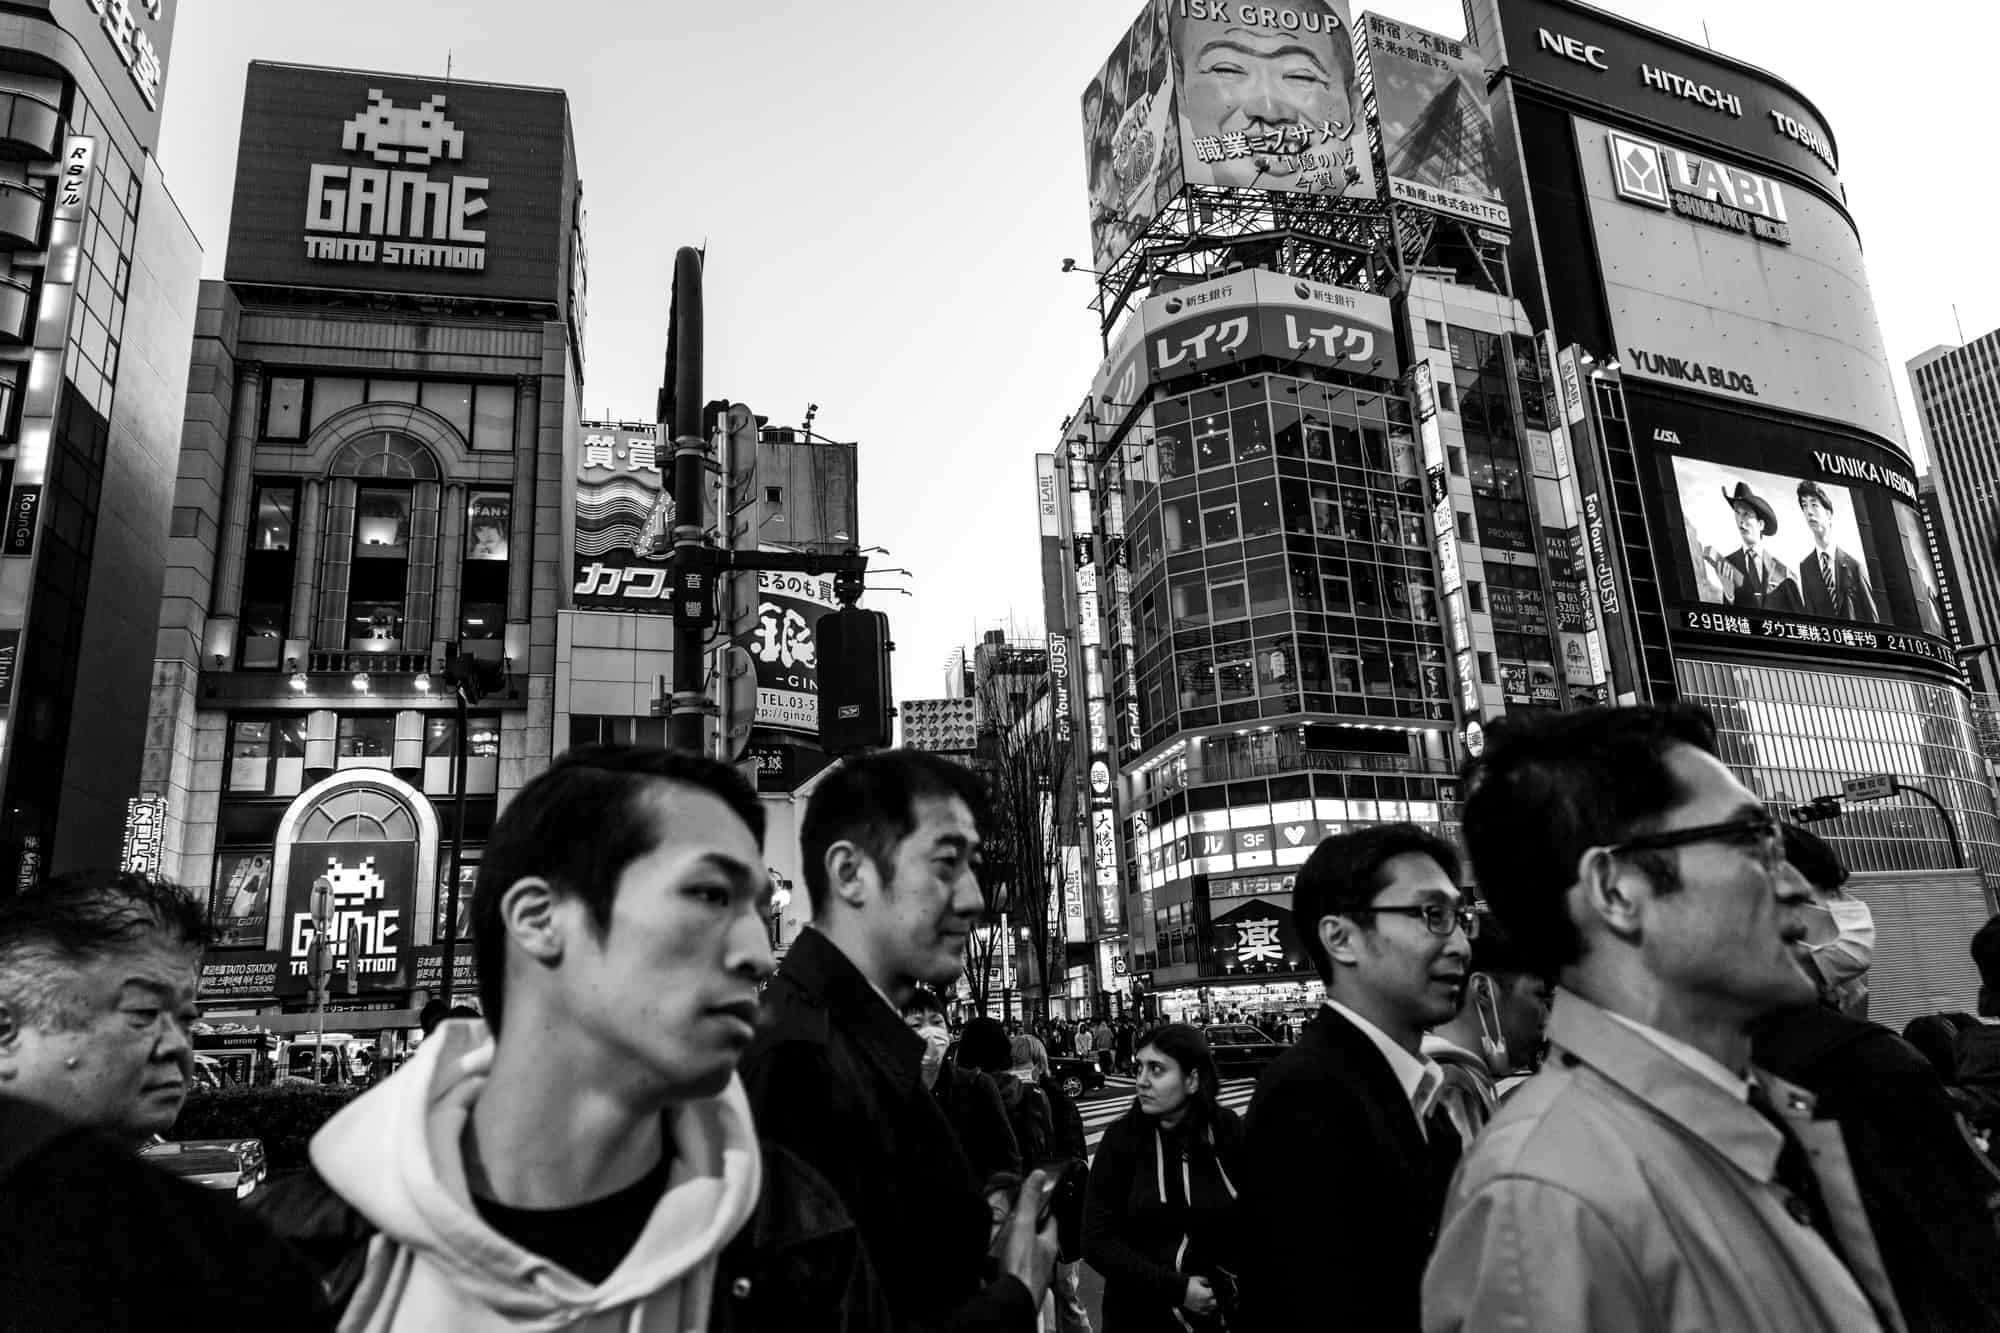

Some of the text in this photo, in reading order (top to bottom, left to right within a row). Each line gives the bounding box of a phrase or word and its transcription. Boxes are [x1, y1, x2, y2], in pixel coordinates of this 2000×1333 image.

[1179, 0, 1341, 35] ISK GROUP
[1539, 27, 1608, 70] NEC
[1642, 63, 1742, 117] HITACHI
[304, 163, 489, 244] GAME
[1663, 146, 1788, 223] LABI
[303, 235, 486, 270] TAITO STATION
[1185, 284, 1233, 306] 新生銀行
[1156, 316, 1249, 369] レイク
[1285, 314, 1375, 361] レイク
[1628, 348, 1759, 396] YUNIKA BLDG.
[1814, 451, 1917, 501] YUNIKA VISION
[1585, 493, 1597, 519] For
[1590, 517, 1603, 553] Your
[575, 562, 675, 600] カワ
[1687, 611, 1751, 635] 29日終値
[1761, 619, 1878, 649] ダウ工業株30種平均
[1056, 687, 1069, 718] Your
[1457, 655, 1478, 711] アイフル
[1243, 833, 1265, 849] 3F
[1234, 917, 1284, 962] 薬
[336, 957, 397, 974] SATION
